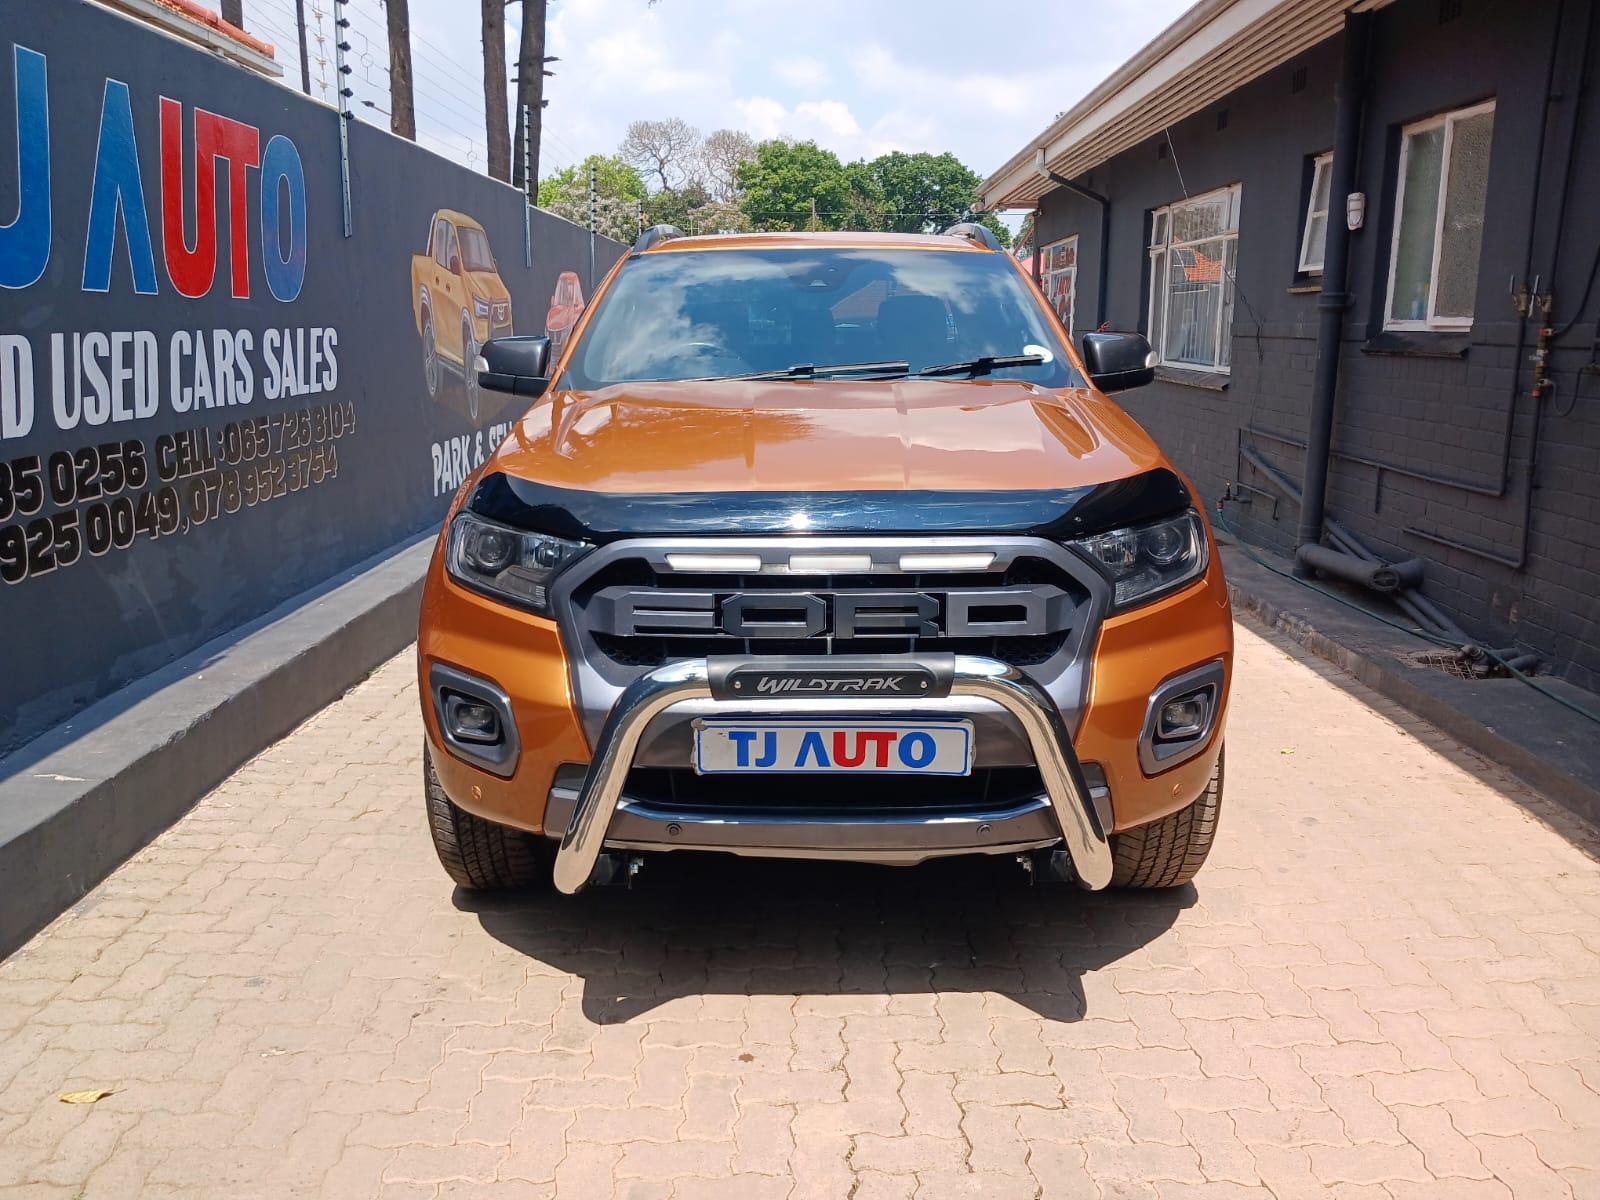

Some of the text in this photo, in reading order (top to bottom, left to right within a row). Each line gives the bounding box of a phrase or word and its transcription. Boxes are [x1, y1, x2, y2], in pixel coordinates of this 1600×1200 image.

[81, 77, 307, 303] AUTO
[50, 330, 159, 430] USED
[170, 328, 254, 413] CARS
[262, 327, 338, 400] SALES
[49, 440, 148, 507] 0256
[432, 434, 471, 497] PARK
[595, 585, 1078, 639] FORD
[757, 676, 907, 694] WILDTRAK
[728, 731, 936, 768] TJ AUTO
